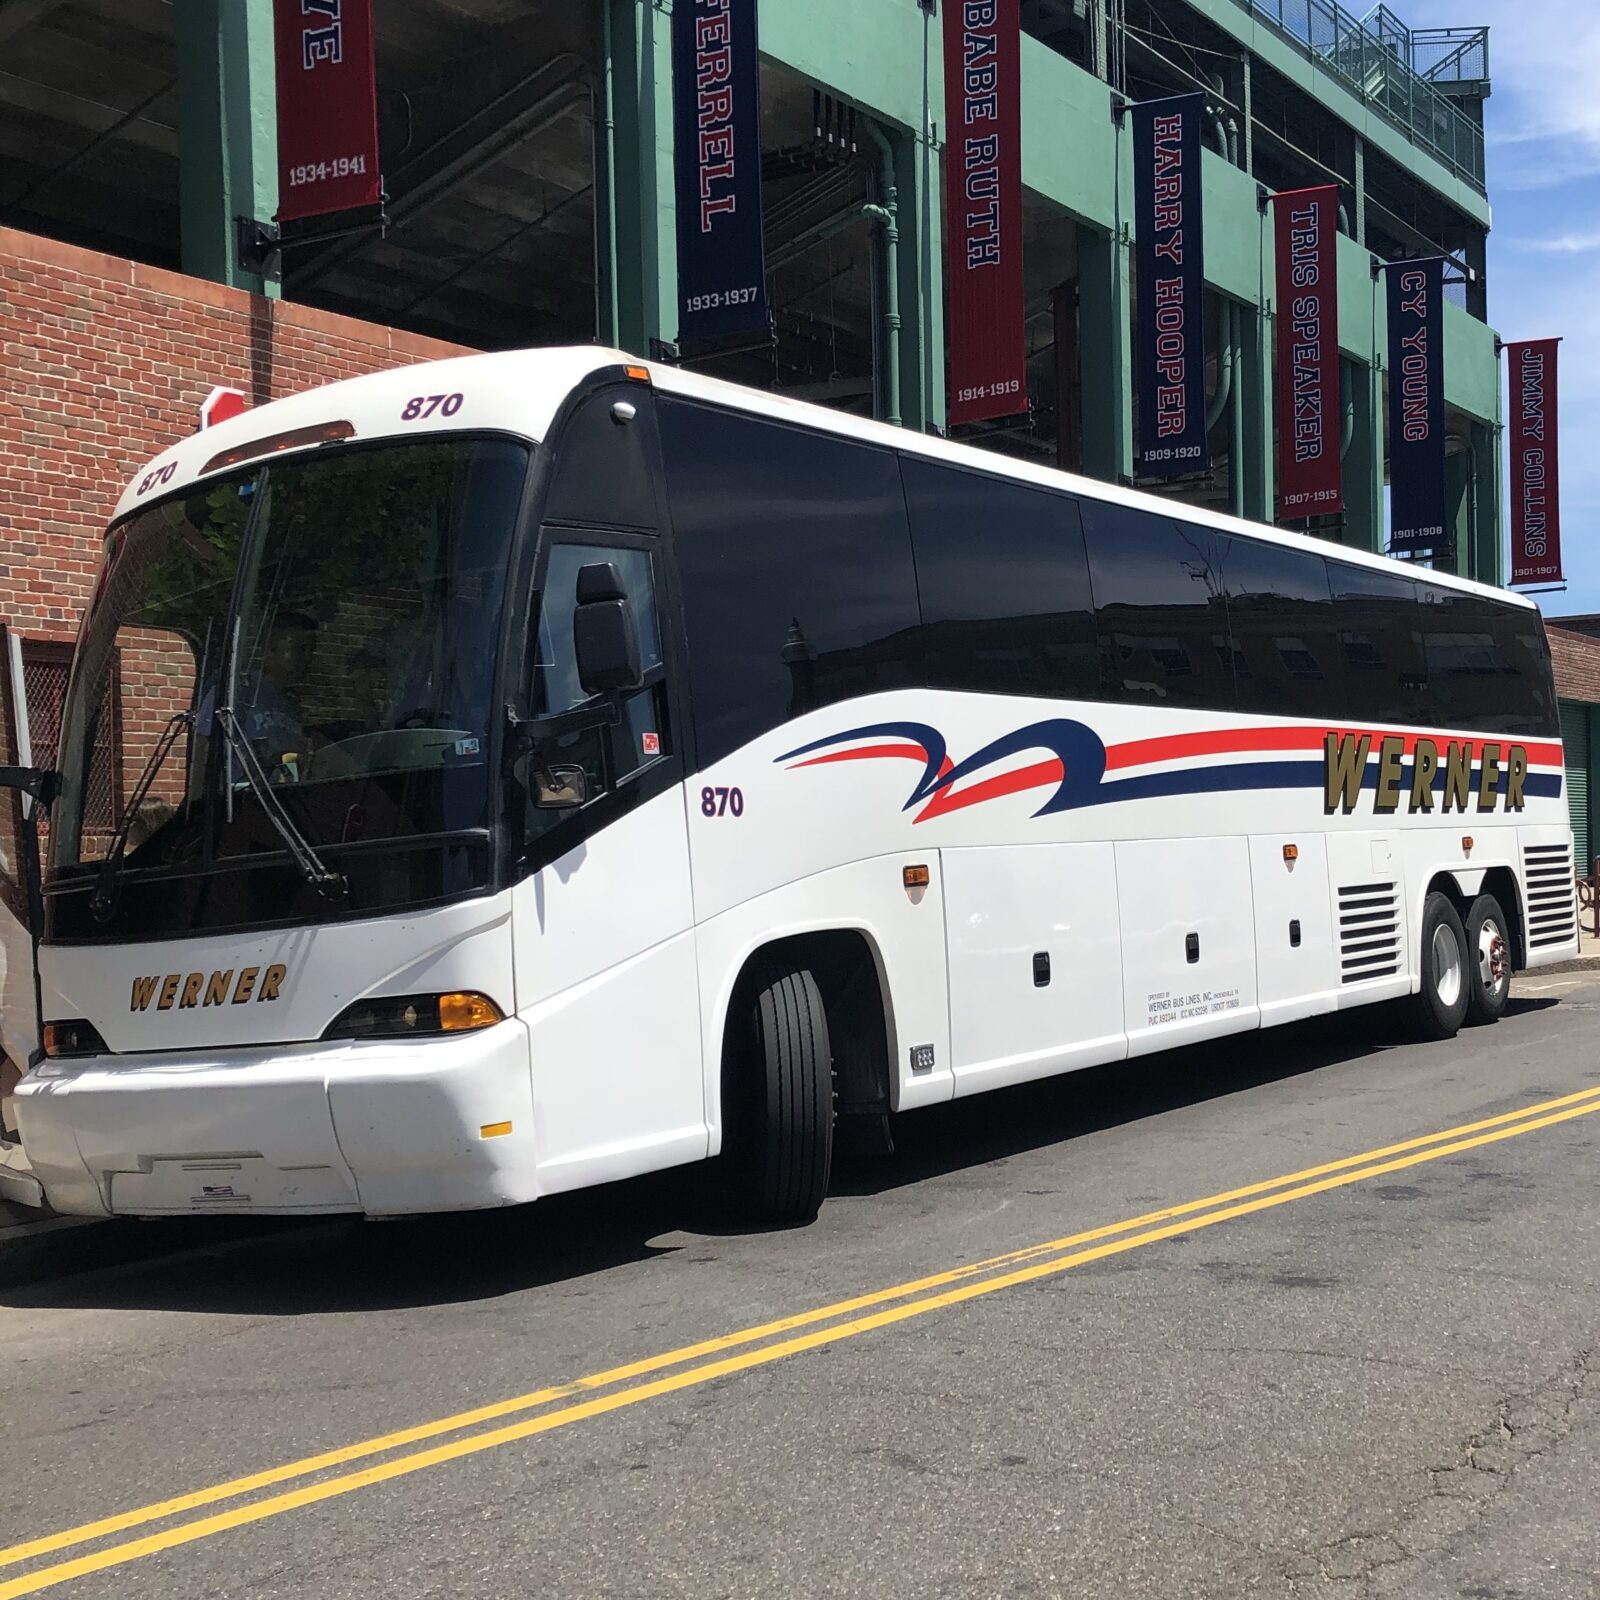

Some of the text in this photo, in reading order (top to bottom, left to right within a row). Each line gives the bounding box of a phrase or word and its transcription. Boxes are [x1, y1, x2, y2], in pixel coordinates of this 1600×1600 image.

[696, 0, 735, 232] ERRELL
[964, 0, 1000, 270] BABE RUTH
[289, 154, 366, 186] 1934-1941
[1155, 113, 1186, 438] HARRY HOOPER
[687, 287, 758, 312] 1933-1937
[1291, 202, 1323, 463] TRIS SPEAKER
[1401, 271, 1428, 441] CY YOUNG
[401, 393, 464, 421] 870
[958, 380, 1019, 403] 1914-1919
[1144, 446, 1201, 461] 1909-1920
[1523, 349, 1546, 557] JIMMY COLLINS
[136, 461, 178, 496] 870
[1284, 489, 1337, 504] 1907-1915
[1393, 526, 1442, 539] 1901-1908
[1513, 566, 1558, 576] 1901-1907
[1323, 731, 1528, 814] WERNER
[702, 786, 744, 817] 870
[130, 963, 287, 1012] WERNER
[1148, 999, 1171, 1013] WERNER
[1173, 997, 1184, 1008] BUS
